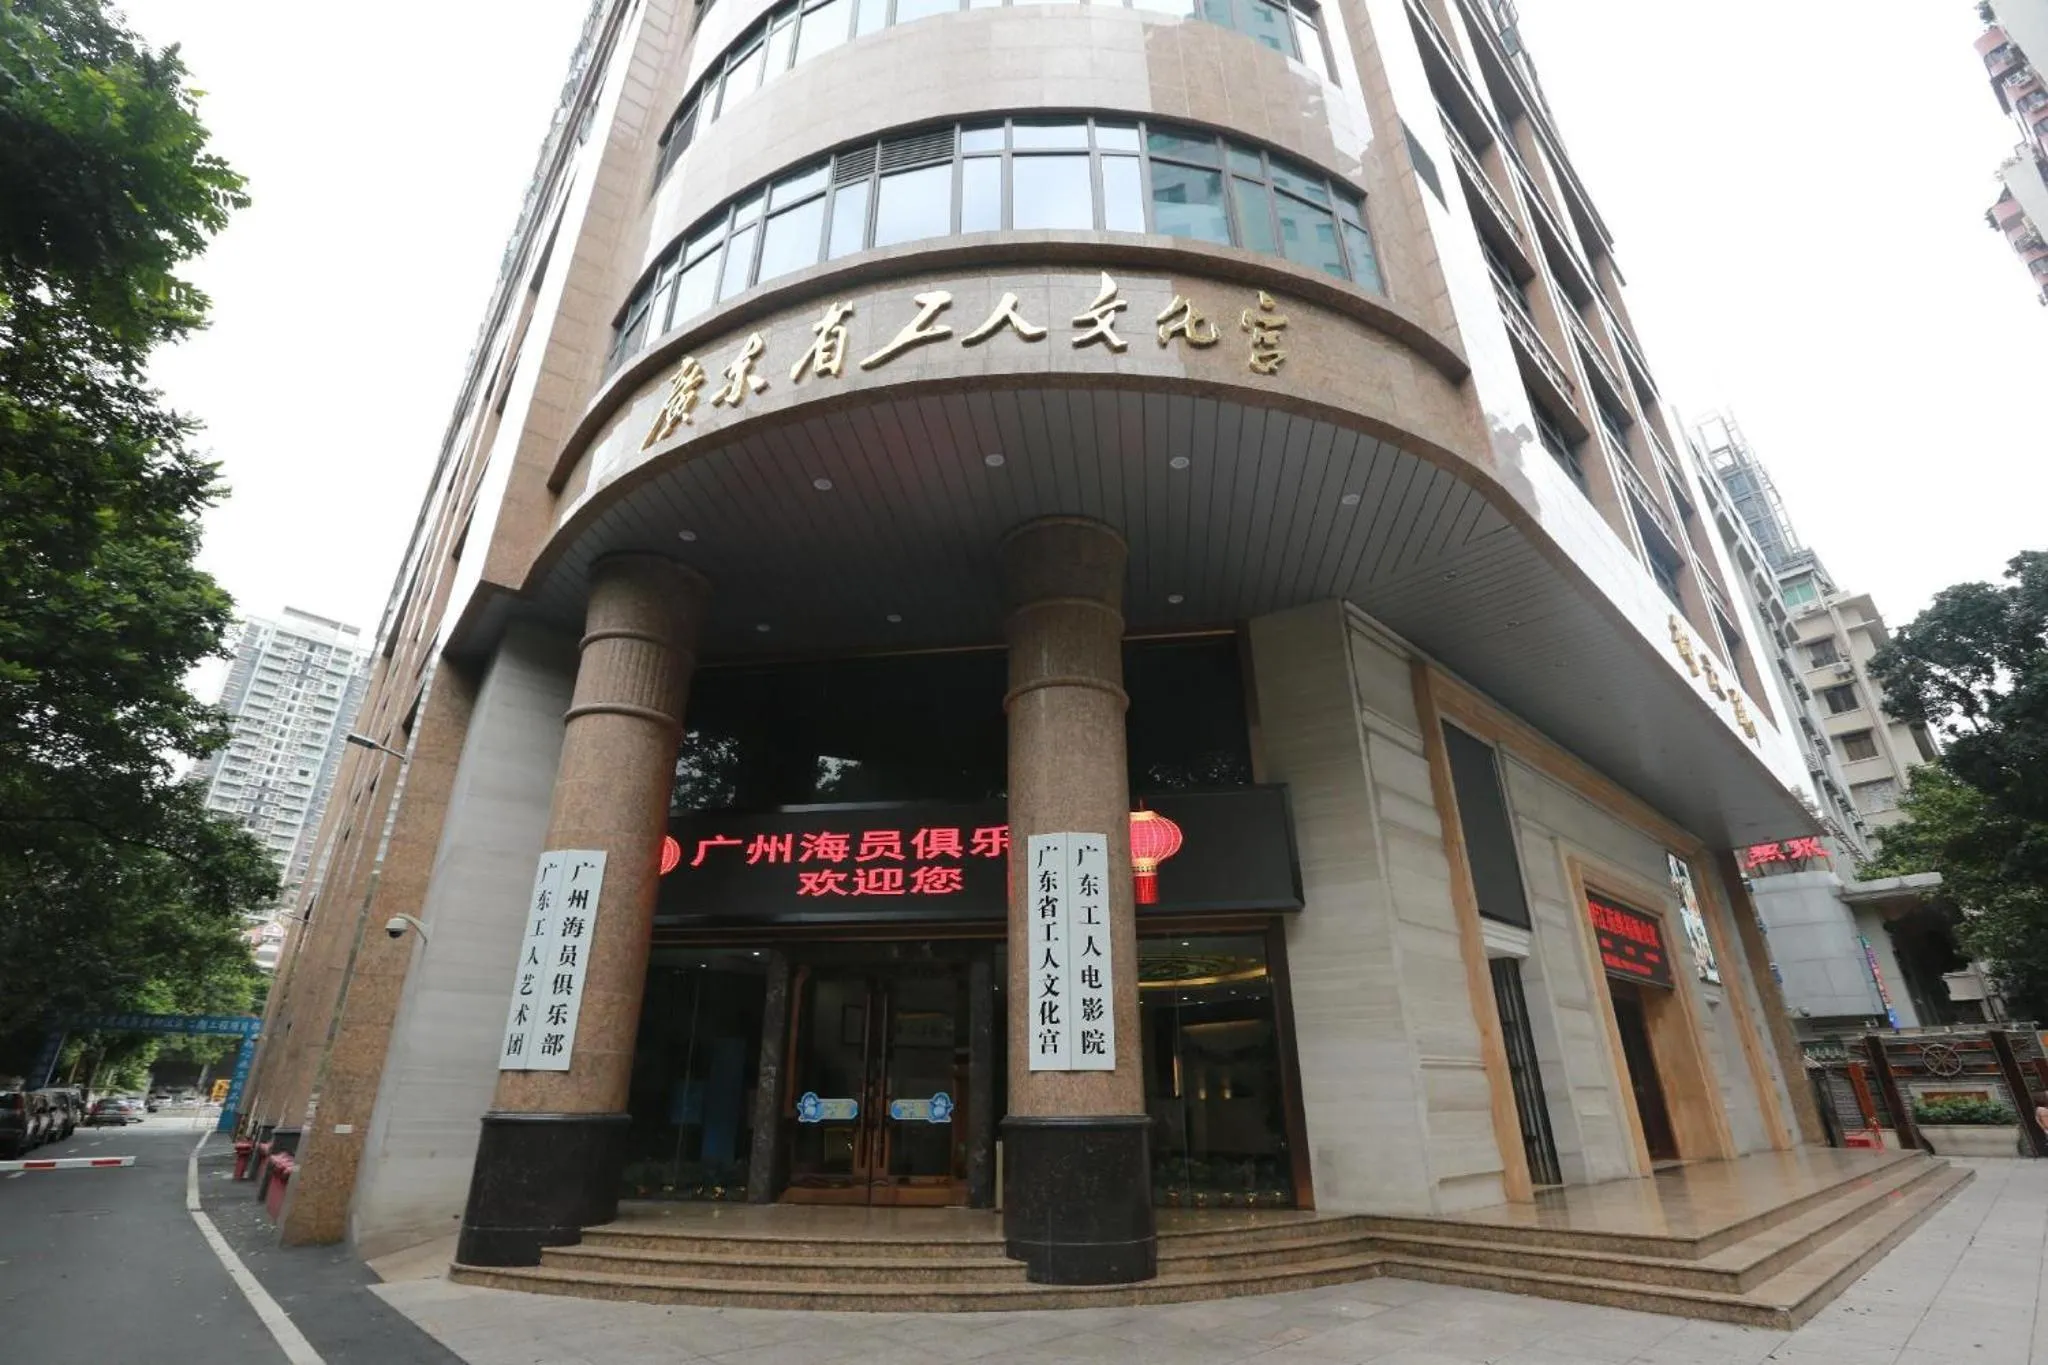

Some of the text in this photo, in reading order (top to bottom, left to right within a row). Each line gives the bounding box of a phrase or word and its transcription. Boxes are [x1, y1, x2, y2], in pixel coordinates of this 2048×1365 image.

[506, 862, 558, 1057] 广东工人艺术团
[540, 861, 596, 1057] 广州海员俱乐部
[796, 866, 965, 898] 欢迎您
[1037, 845, 1061, 1055] 广东省工人文化宫
[1076, 845, 1106, 1055] 广东工人电影院
